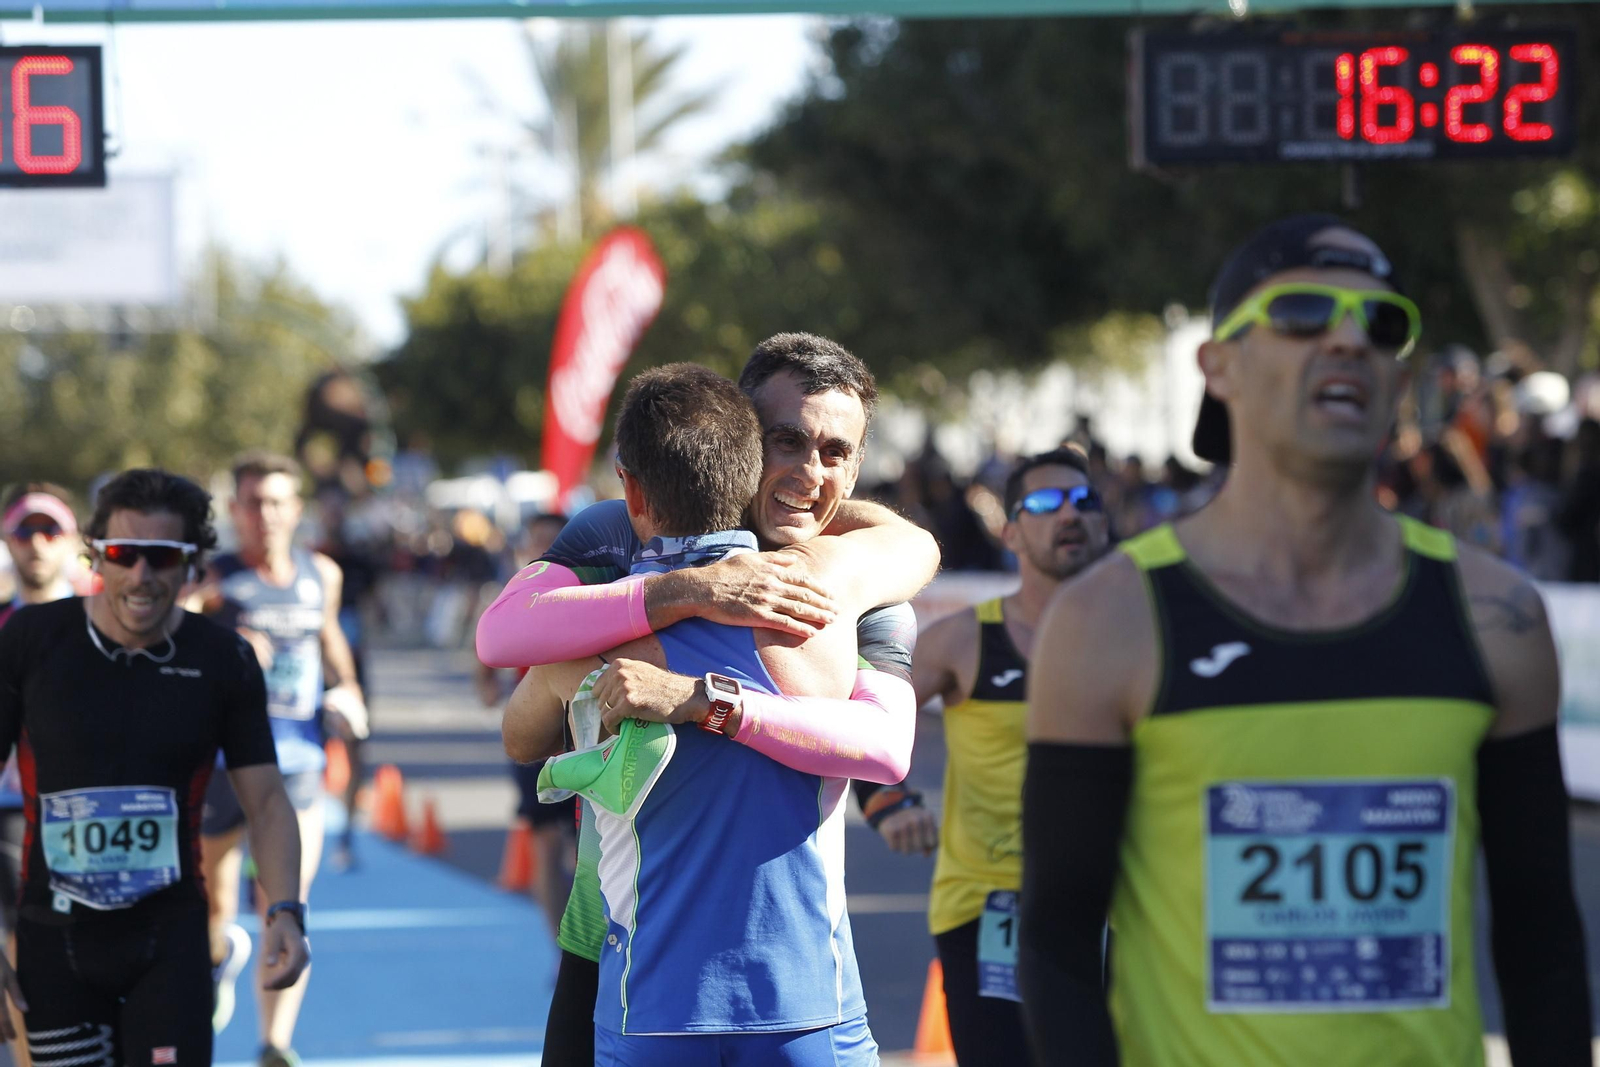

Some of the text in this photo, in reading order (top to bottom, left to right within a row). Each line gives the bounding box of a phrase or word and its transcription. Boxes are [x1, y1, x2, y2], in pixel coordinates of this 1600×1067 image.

[1336, 43, 1559, 144] 16:22
[62, 819, 160, 857] 1049
[1239, 842, 1427, 903] 2105
